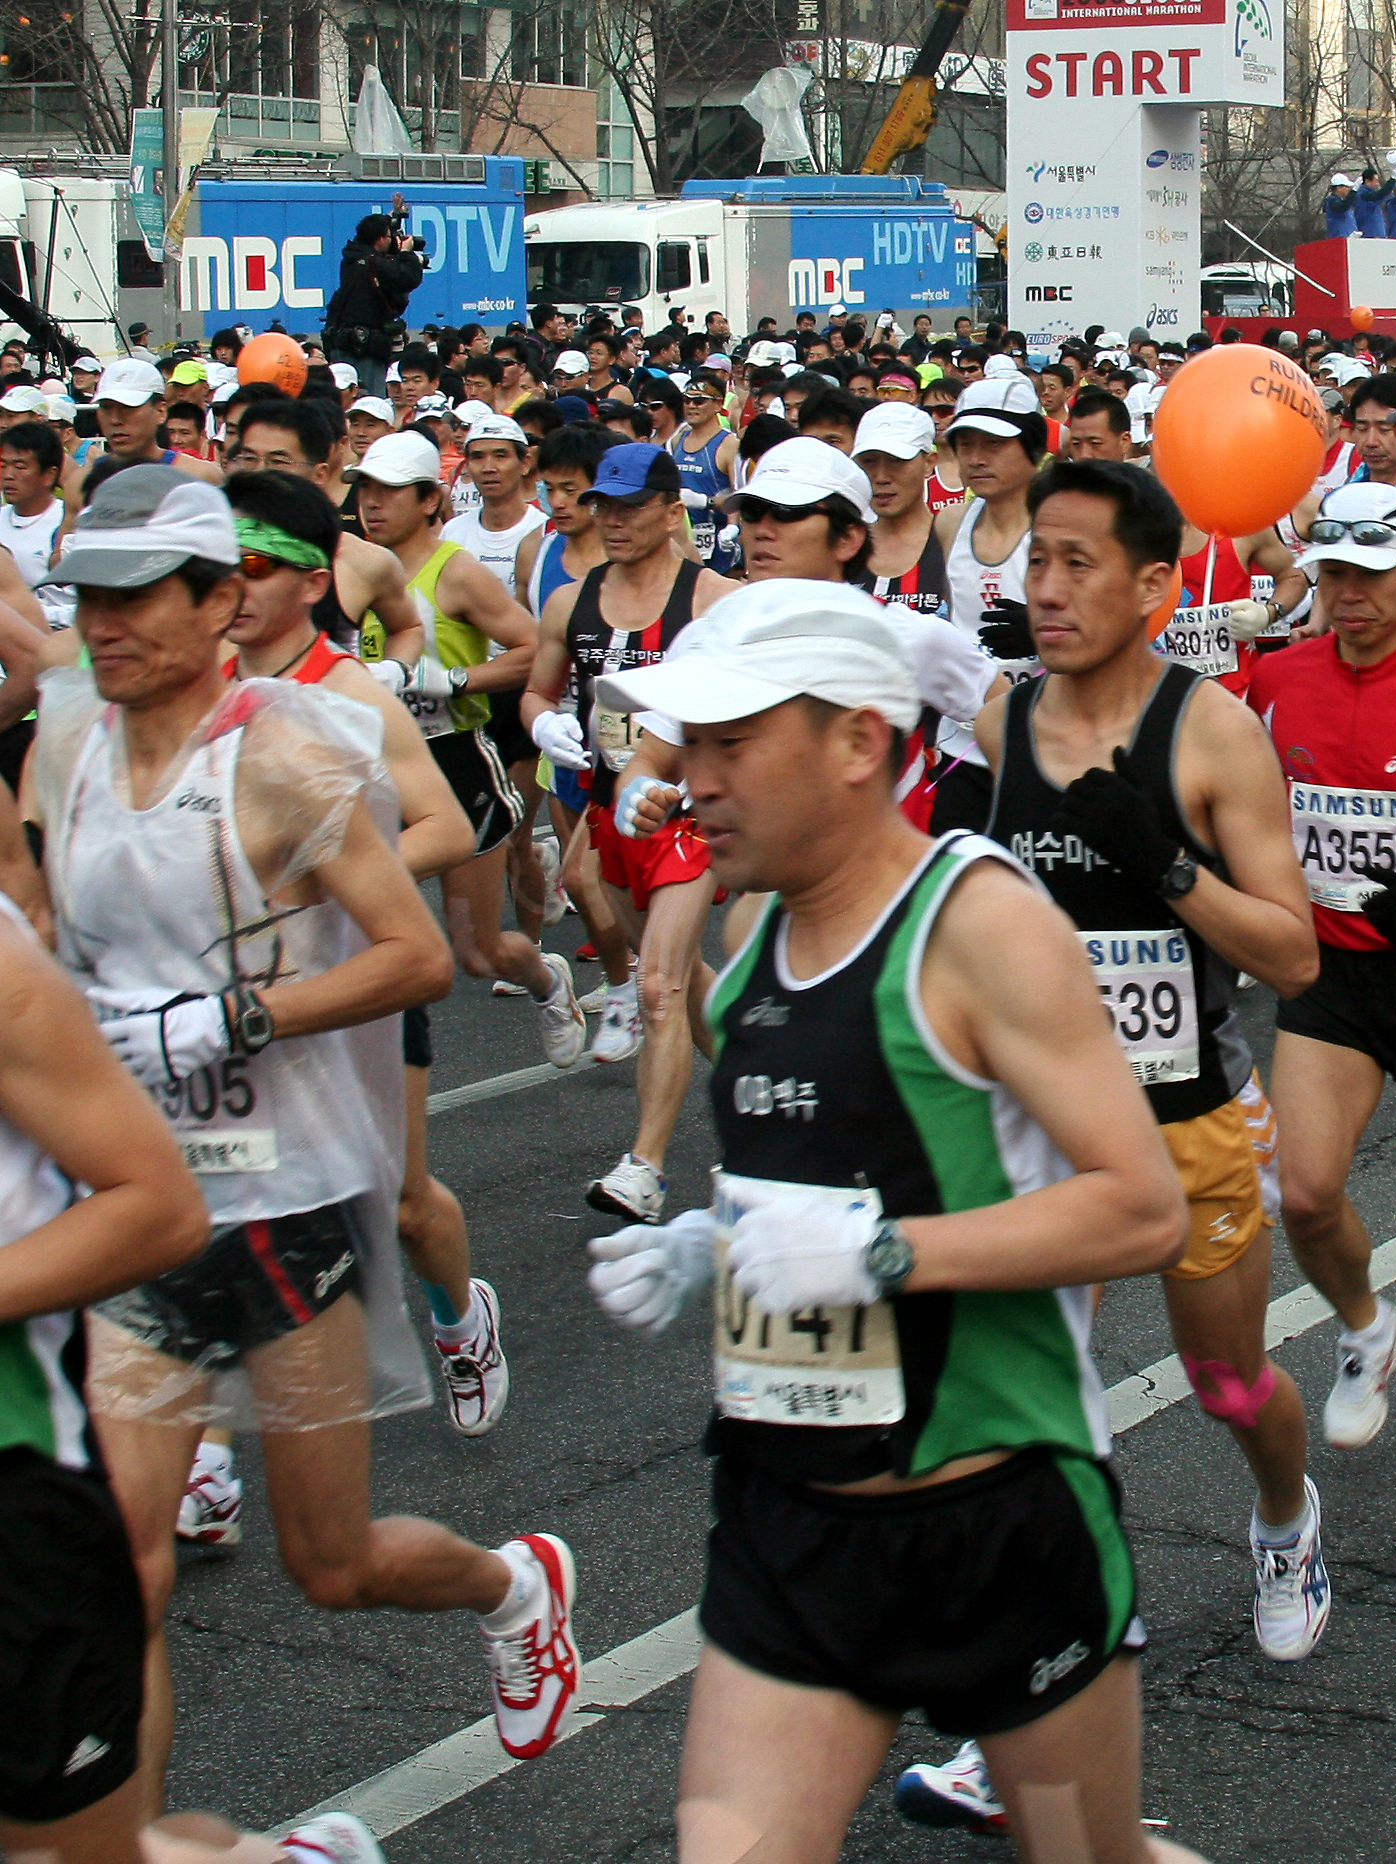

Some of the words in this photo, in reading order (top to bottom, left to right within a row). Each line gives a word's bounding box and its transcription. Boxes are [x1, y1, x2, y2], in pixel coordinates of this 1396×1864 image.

[1061, 7, 1142, 19] INTERNATIONAL
[1145, 4, 1201, 15] MARATHON
[1026, 49, 1201, 99] START
[1047, 165, 1096, 182] 서울특별시
[372, 205, 512, 274] DTV
[873, 222, 947, 265] HDTV
[1048, 244, 1103, 260] 東亞日報
[180, 236, 323, 312] MBC
[789, 257, 864, 307] MBC
[1025, 285, 1073, 301] MBC
[1086, 937, 1186, 966] SUNG
